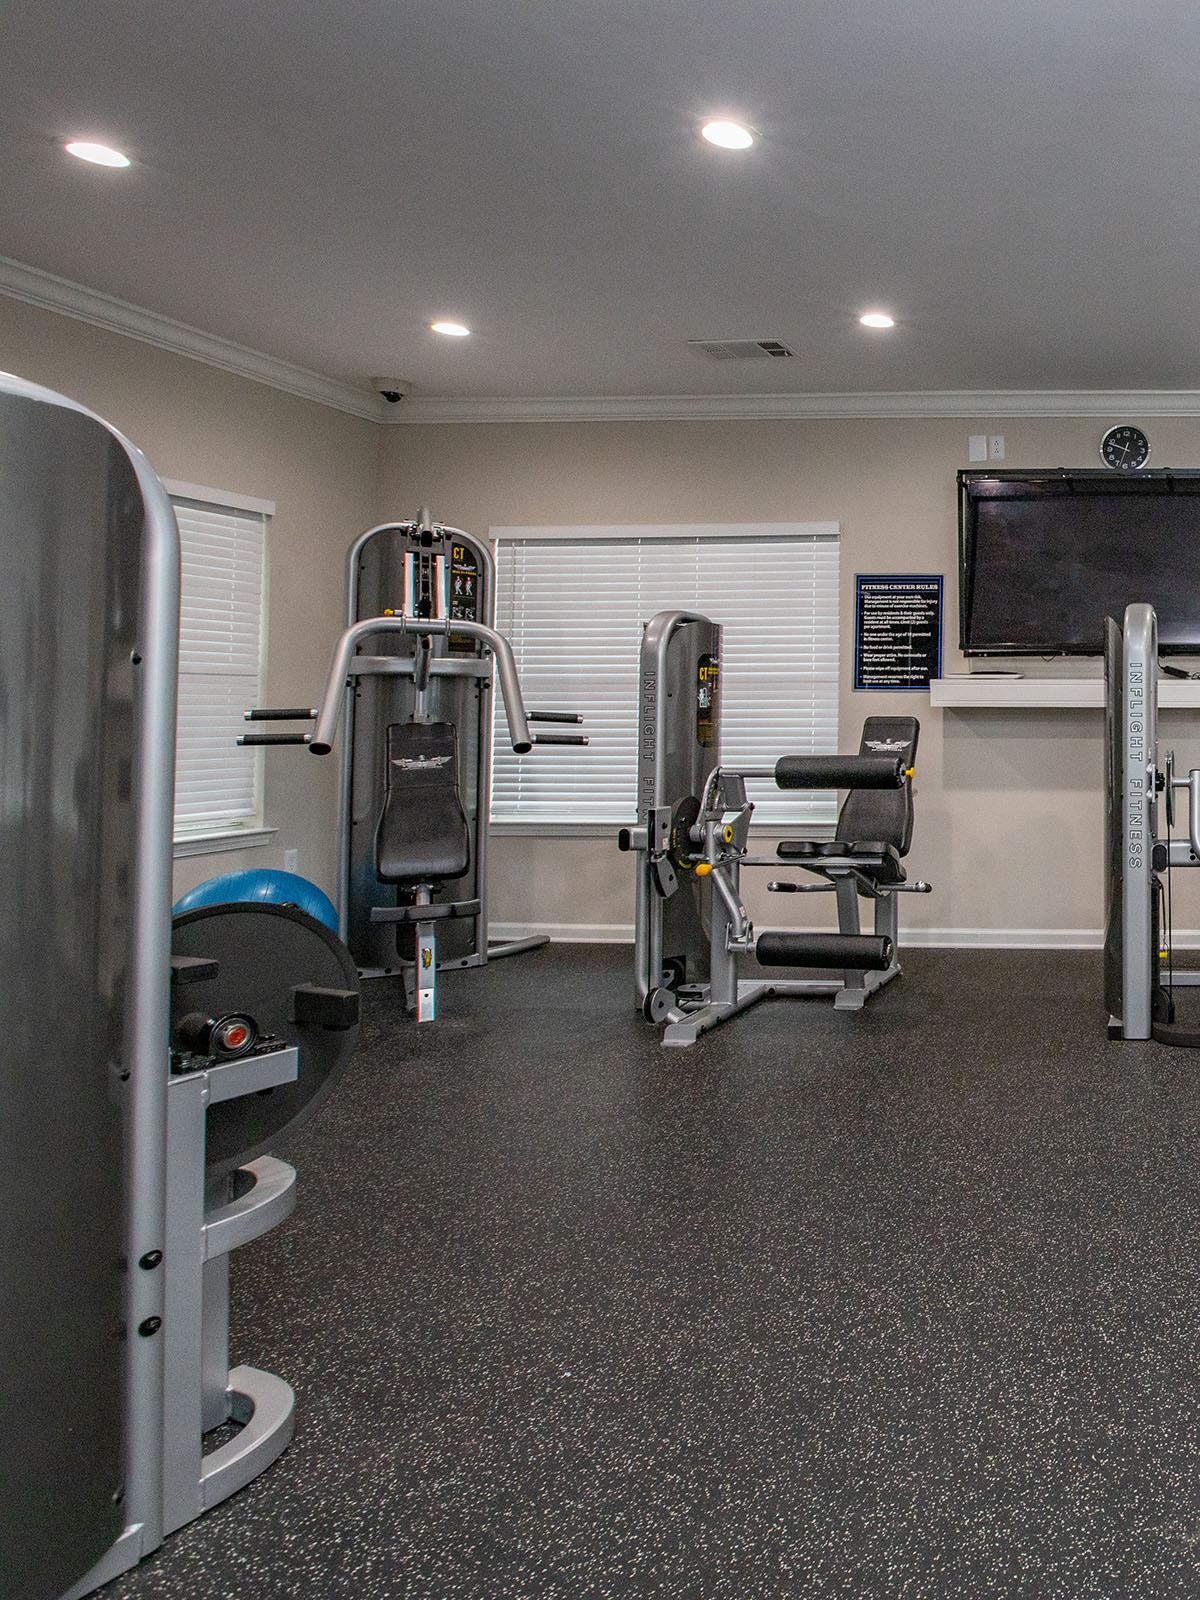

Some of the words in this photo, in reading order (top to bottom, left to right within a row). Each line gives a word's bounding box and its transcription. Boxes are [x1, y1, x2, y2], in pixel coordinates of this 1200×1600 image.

[453, 547, 465, 560] CT
[643, 672, 655, 762] INFLIGHT
[699, 667, 708, 681] CT
[1129, 662, 1144, 762] INFLIGHT
[1129, 778, 1144, 869] FITNESS
